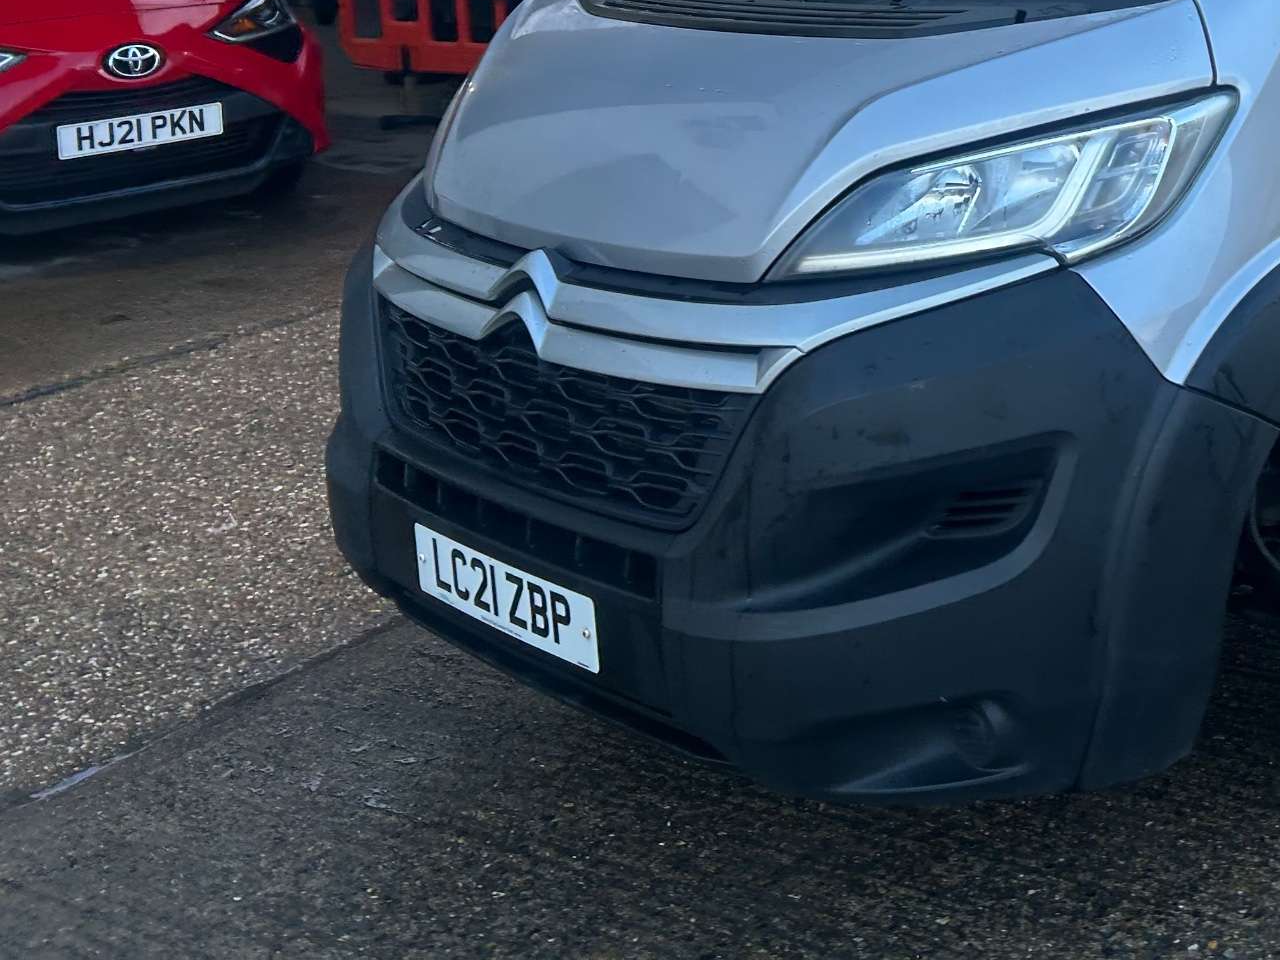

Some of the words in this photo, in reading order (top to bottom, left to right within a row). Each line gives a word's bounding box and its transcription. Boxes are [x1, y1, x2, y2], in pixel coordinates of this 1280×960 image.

[76, 118, 142, 151] HJ21
[151, 108, 205, 139] PKN
[432, 537, 499, 617] LC21
[505, 571, 571, 645] ZBP
